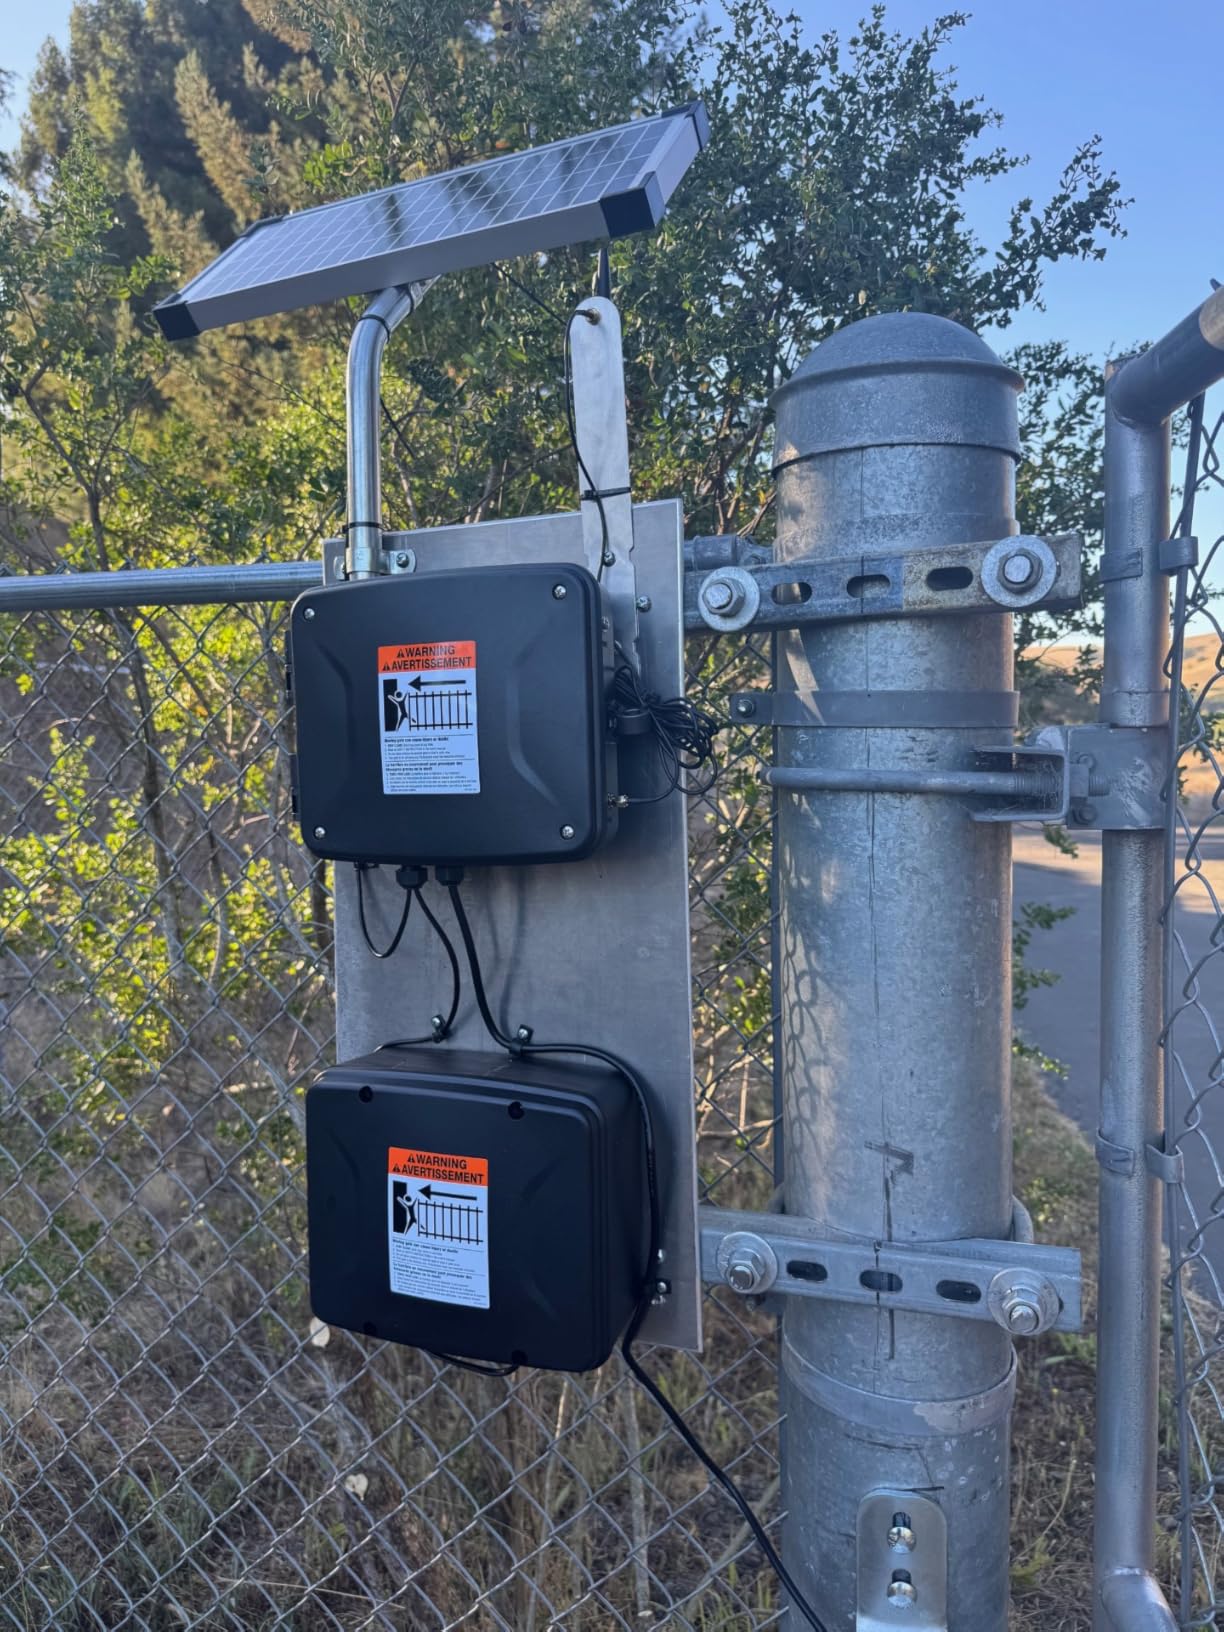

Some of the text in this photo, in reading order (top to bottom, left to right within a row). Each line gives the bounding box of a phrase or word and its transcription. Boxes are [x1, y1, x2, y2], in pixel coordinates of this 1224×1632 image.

[405, 645, 455, 658] WARNING
[391, 656, 472, 670] AVERTISSEMENT
[416, 1154, 467, 1170] WARNING
[401, 1164, 485, 1184] AVERTISSEMENT
